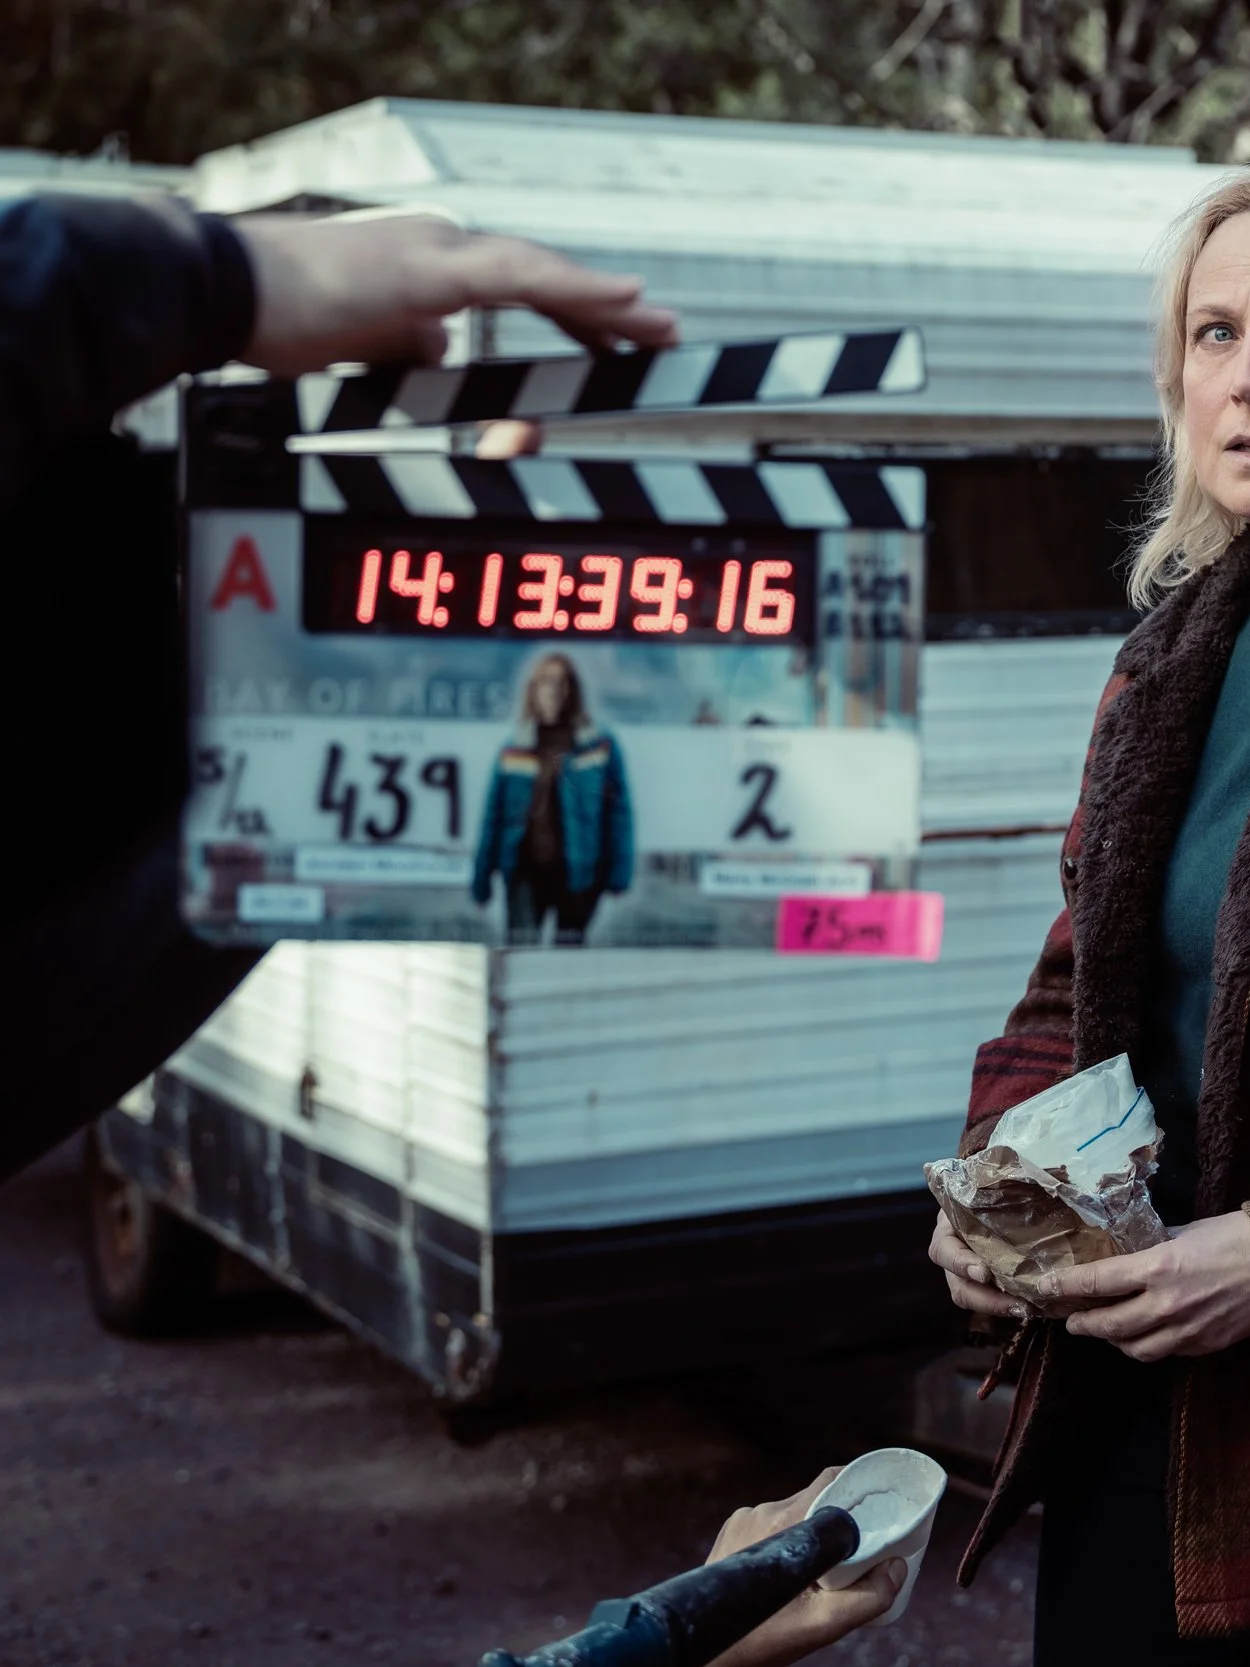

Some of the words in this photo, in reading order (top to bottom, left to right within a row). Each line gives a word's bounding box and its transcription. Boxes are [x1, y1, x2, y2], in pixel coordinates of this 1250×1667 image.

[210, 534, 277, 613] A
[317, 740, 463, 843] 439
[729, 761, 794, 842] 2
